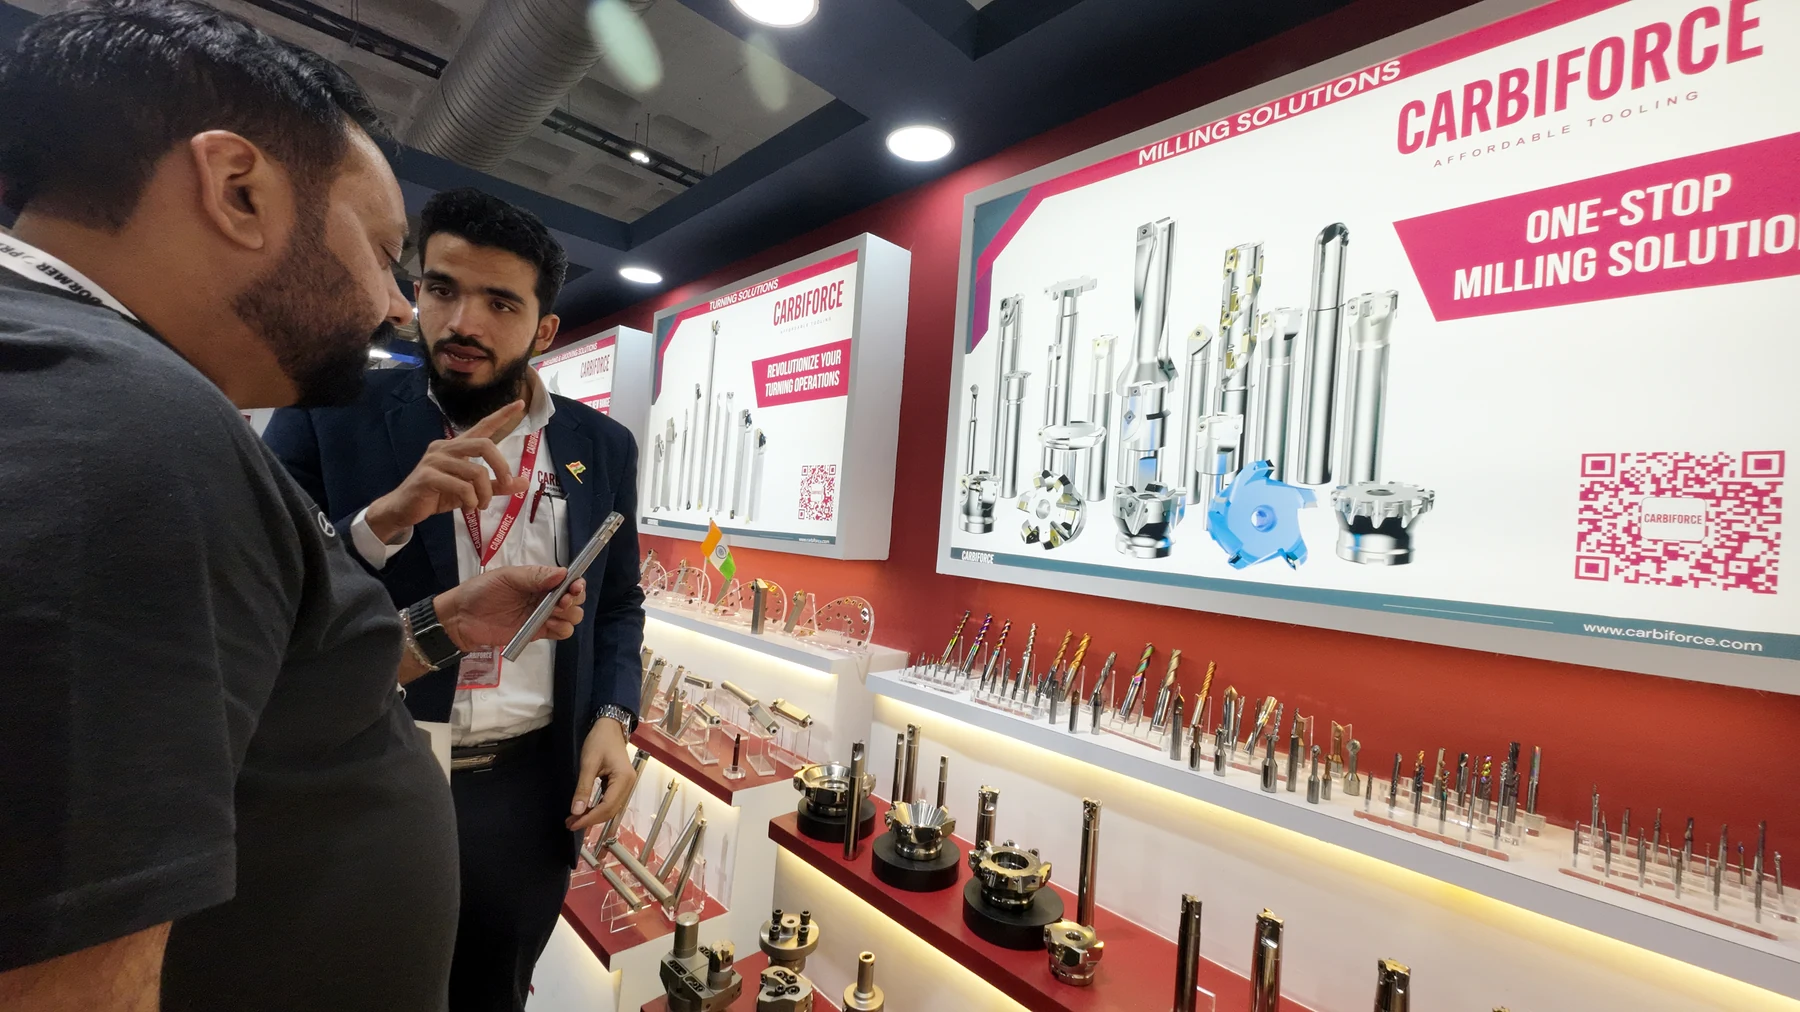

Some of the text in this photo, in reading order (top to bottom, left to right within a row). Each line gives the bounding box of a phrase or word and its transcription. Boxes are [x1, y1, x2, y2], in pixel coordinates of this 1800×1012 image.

[1397, 0, 1764, 155] CARBIFORCE
[1138, 60, 1401, 166] MILLING SOLUTIONS
[1433, 90, 1699, 169] AFFORDABLE TOOLING
[1526, 172, 1732, 244] ONE-STOP
[1453, 213, 1800, 300] MILLING SOLUTIO
[709, 278, 779, 311] TURNING SOLUTIONS
[773, 279, 845, 326] CARBIFORCE
[580, 354, 611, 379] CARBIFORCE
[767, 349, 842, 379] REVOLUTIONIZE YOUR
[765, 370, 840, 398] TURNING OPERATIONS
[489, 514, 515, 551] CARBIFORCE
[1643, 513, 1703, 525] CARBIFORCE
[961, 550, 995, 565] CARBIFORCE
[1583, 623, 1763, 652] www.carbiforce.com
